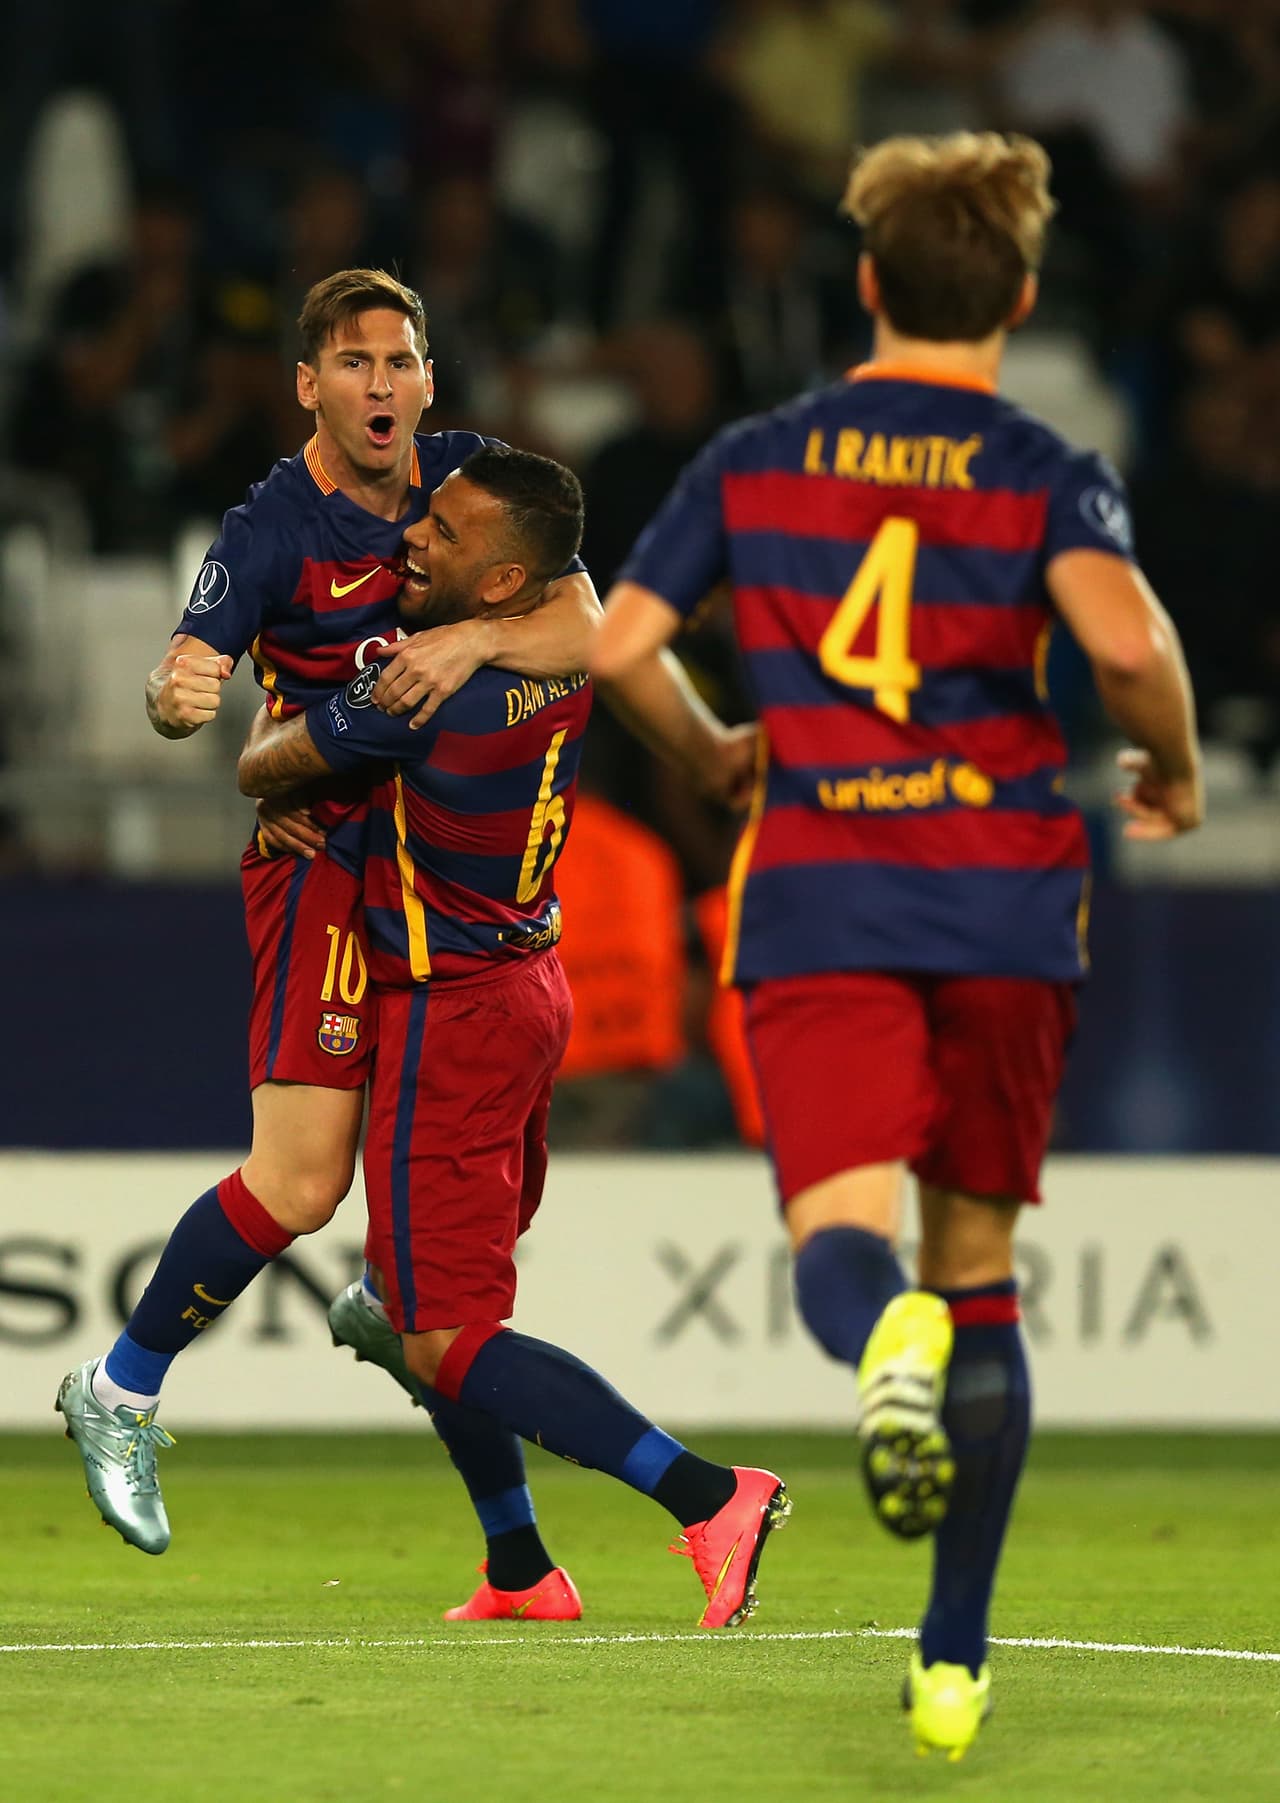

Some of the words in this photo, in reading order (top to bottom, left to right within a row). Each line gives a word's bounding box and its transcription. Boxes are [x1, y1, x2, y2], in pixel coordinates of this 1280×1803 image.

[834, 426, 983, 491] RAKITIĆ
[819, 516, 920, 723] 4
[516, 728, 567, 904] 6
[817, 758, 947, 812] unicef
[320, 924, 368, 1005] 10
[0, 1233, 532, 1346] SON
[653, 1239, 1213, 1347] XRIA
